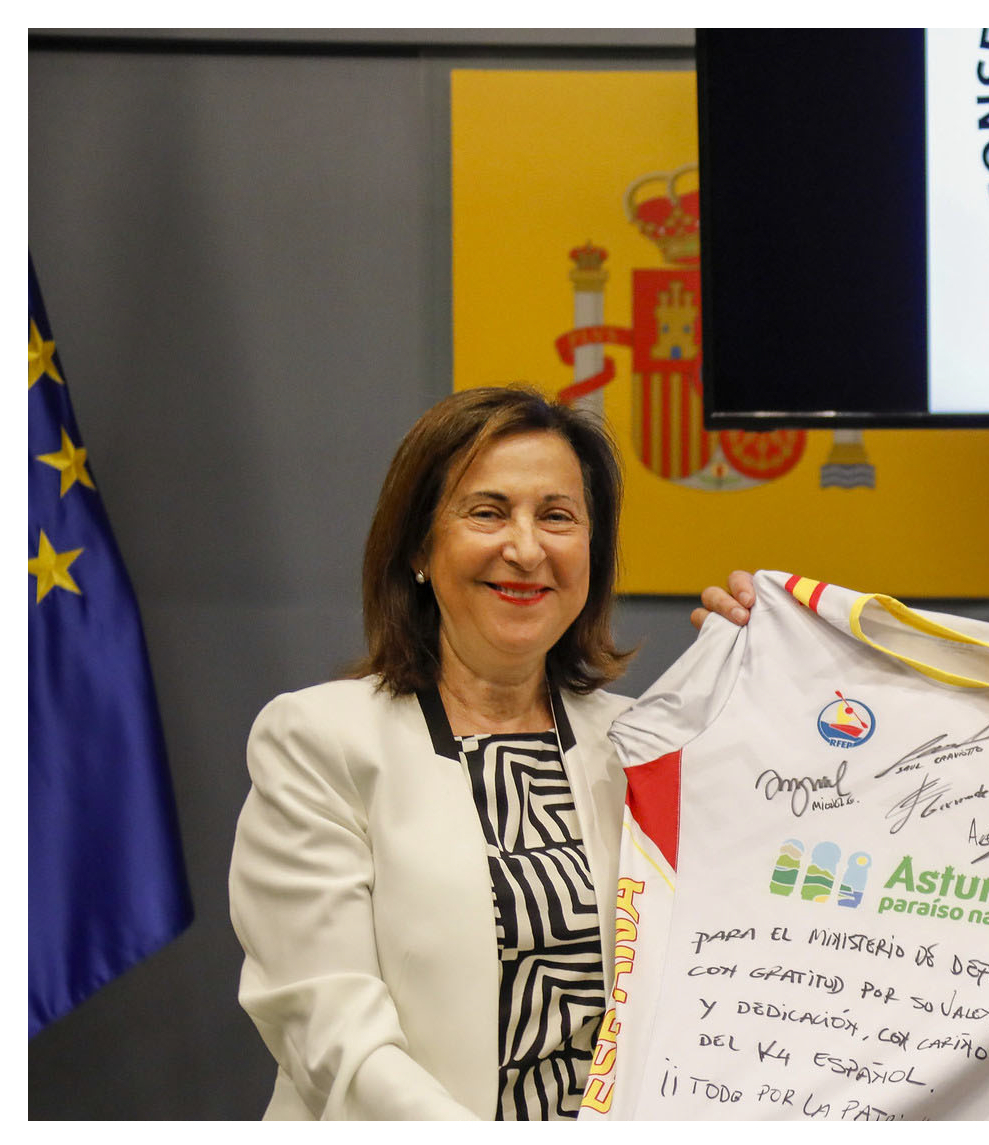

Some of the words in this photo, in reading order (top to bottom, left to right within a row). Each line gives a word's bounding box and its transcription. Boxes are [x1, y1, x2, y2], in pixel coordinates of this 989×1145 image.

[878, 897, 964, 921] paraíso
[691, 927, 756, 954] PARA
[771, 927, 792, 942] EL
[687, 965, 737, 979] CON
[861, 981, 900, 1004] POR
[699, 998, 717, 1020] Y
[878, 1028, 910, 1051] CON
[699, 1033, 740, 1051] DEL
[758, 1040, 790, 1067] K4
[757, 1084, 795, 1106] POR
